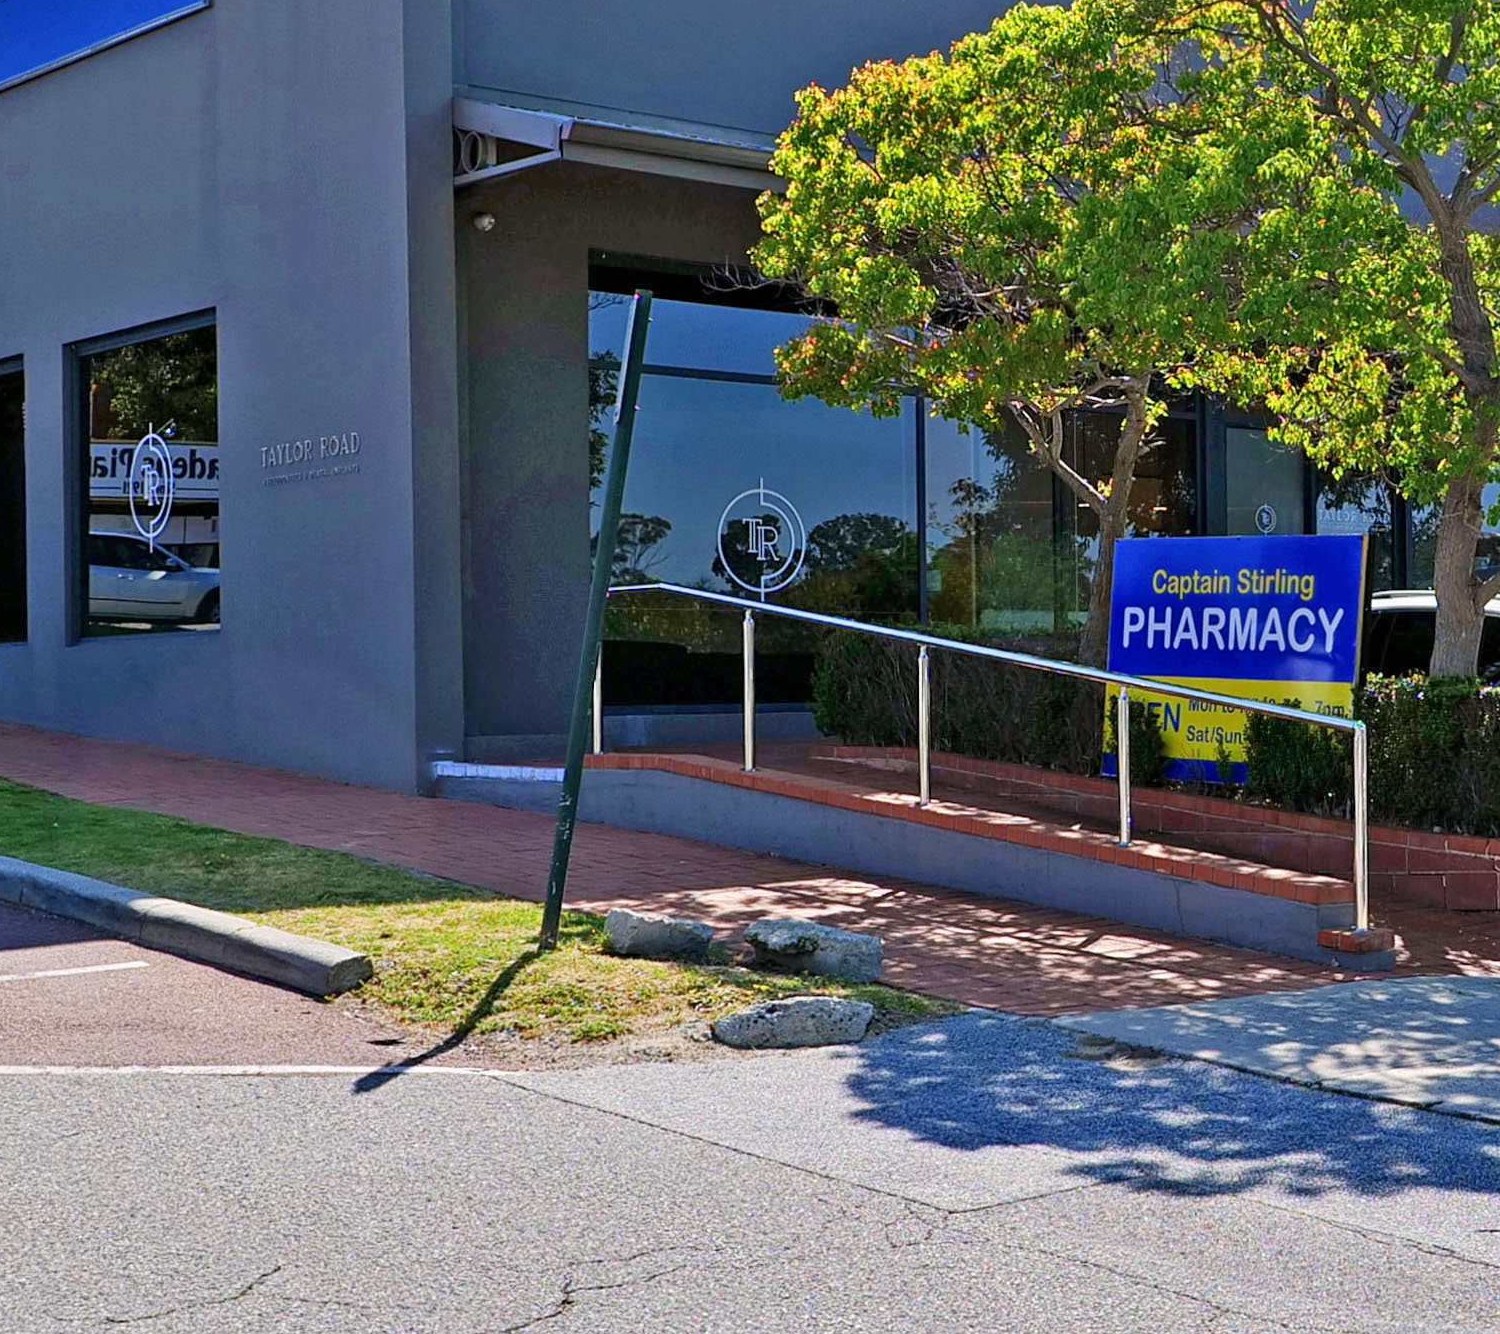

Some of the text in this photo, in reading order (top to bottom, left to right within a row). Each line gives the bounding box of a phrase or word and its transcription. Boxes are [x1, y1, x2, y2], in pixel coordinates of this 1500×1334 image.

[260, 432, 361, 468] TAYLOR ROAD
[140, 463, 161, 507] TR
[742, 517, 780, 562] TR
[1152, 568, 1315, 601] Captain Stirling
[1122, 605, 1344, 654] PHARMACY
